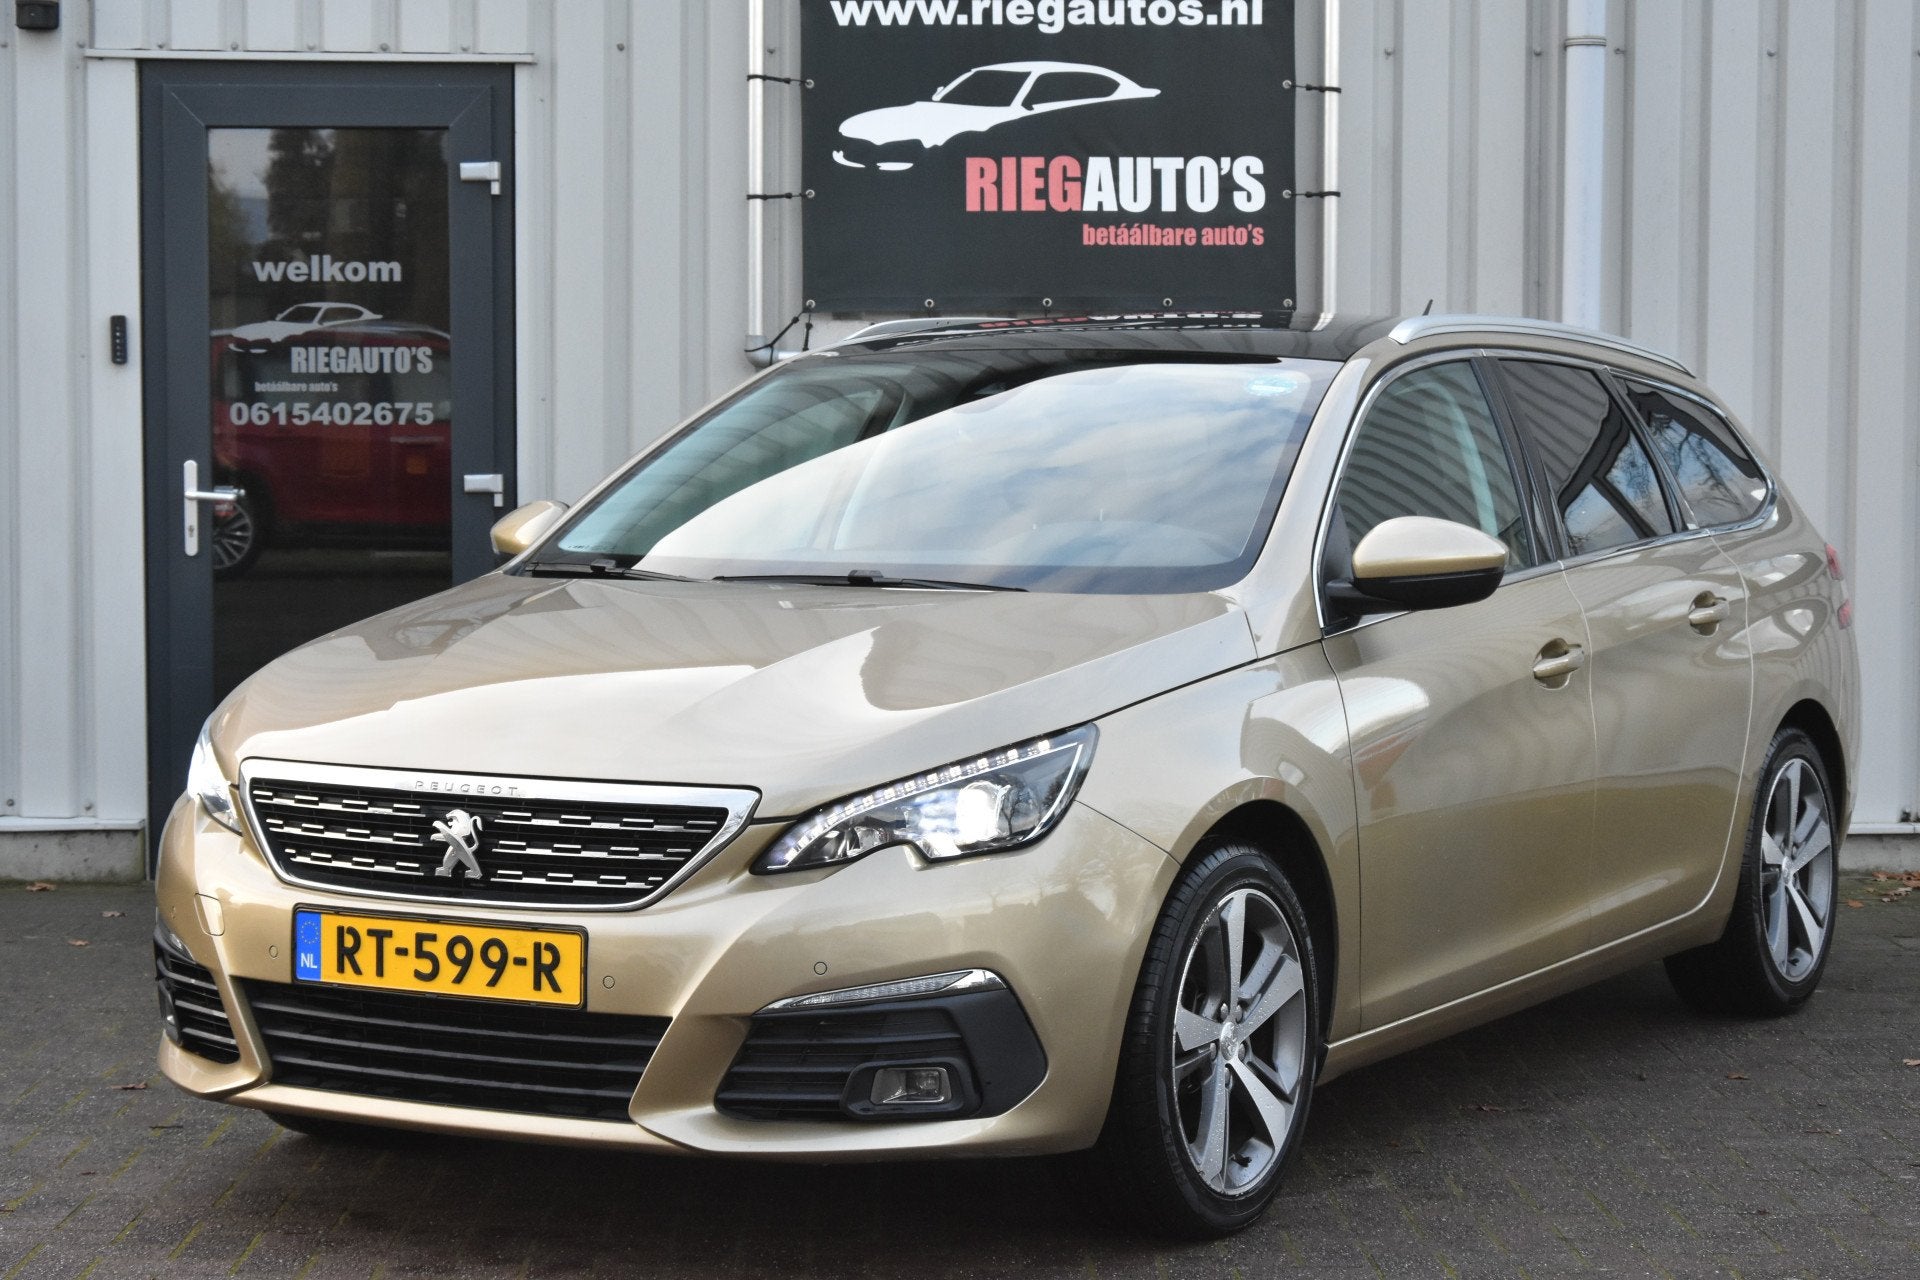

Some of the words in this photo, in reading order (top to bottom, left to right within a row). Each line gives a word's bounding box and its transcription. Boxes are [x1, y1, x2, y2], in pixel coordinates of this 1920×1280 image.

[829, 0, 1263, 34] www.riegautos.nl
[965, 155, 1266, 213] RIEGAUTO'S
[1082, 222, 1197, 247] betáálbare
[1200, 223, 1265, 246] auto's
[252, 254, 402, 282] welkom
[290, 346, 433, 374] RIEGAUTO'S
[229, 402, 434, 426] 0615402675
[414, 779, 519, 797] PEUGEOT
[300, 952, 318, 969] NL
[336, 924, 563, 994] RT-599-R
